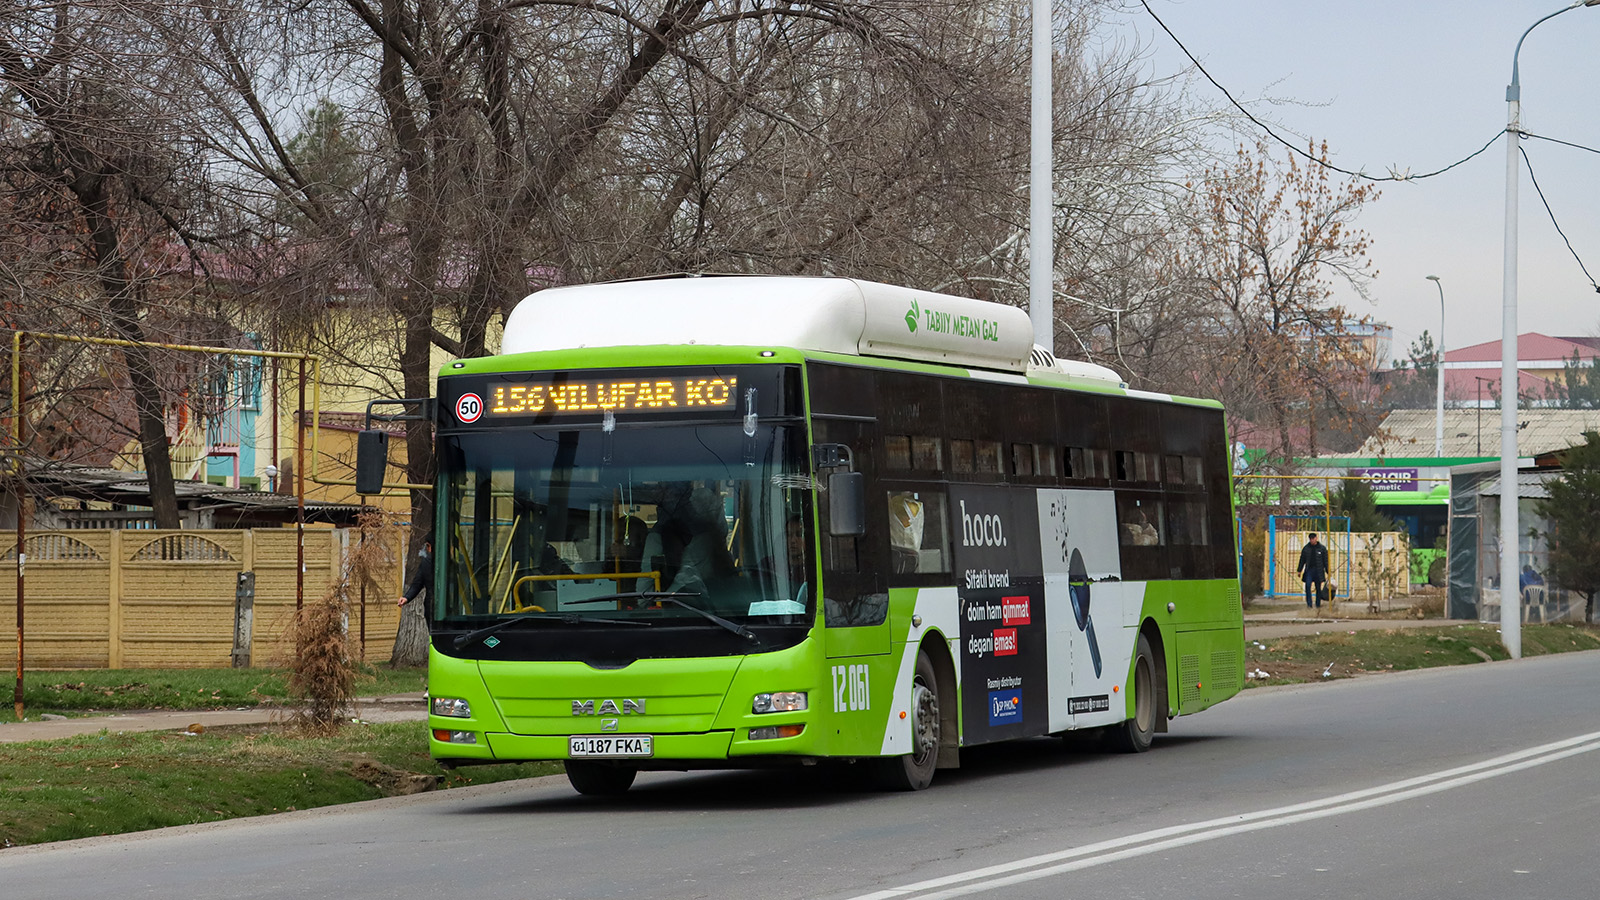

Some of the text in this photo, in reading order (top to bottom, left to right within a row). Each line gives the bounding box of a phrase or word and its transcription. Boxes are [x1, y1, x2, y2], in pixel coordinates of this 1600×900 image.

[924, 309, 998, 342] TABIIY METAN GAZ
[460, 401, 478, 414] 50
[492, 386, 545, 413] 156
[960, 499, 1007, 547] hoco.
[965, 569, 1009, 589] Sifatli brend
[967, 600, 1029, 623] doim ham qimmat
[968, 631, 1015, 658] degani emas!
[831, 664, 870, 713] 12 061
[571, 699, 646, 715] MAN
[588, 739, 612, 753] 187
[615, 739, 643, 753] FKA
